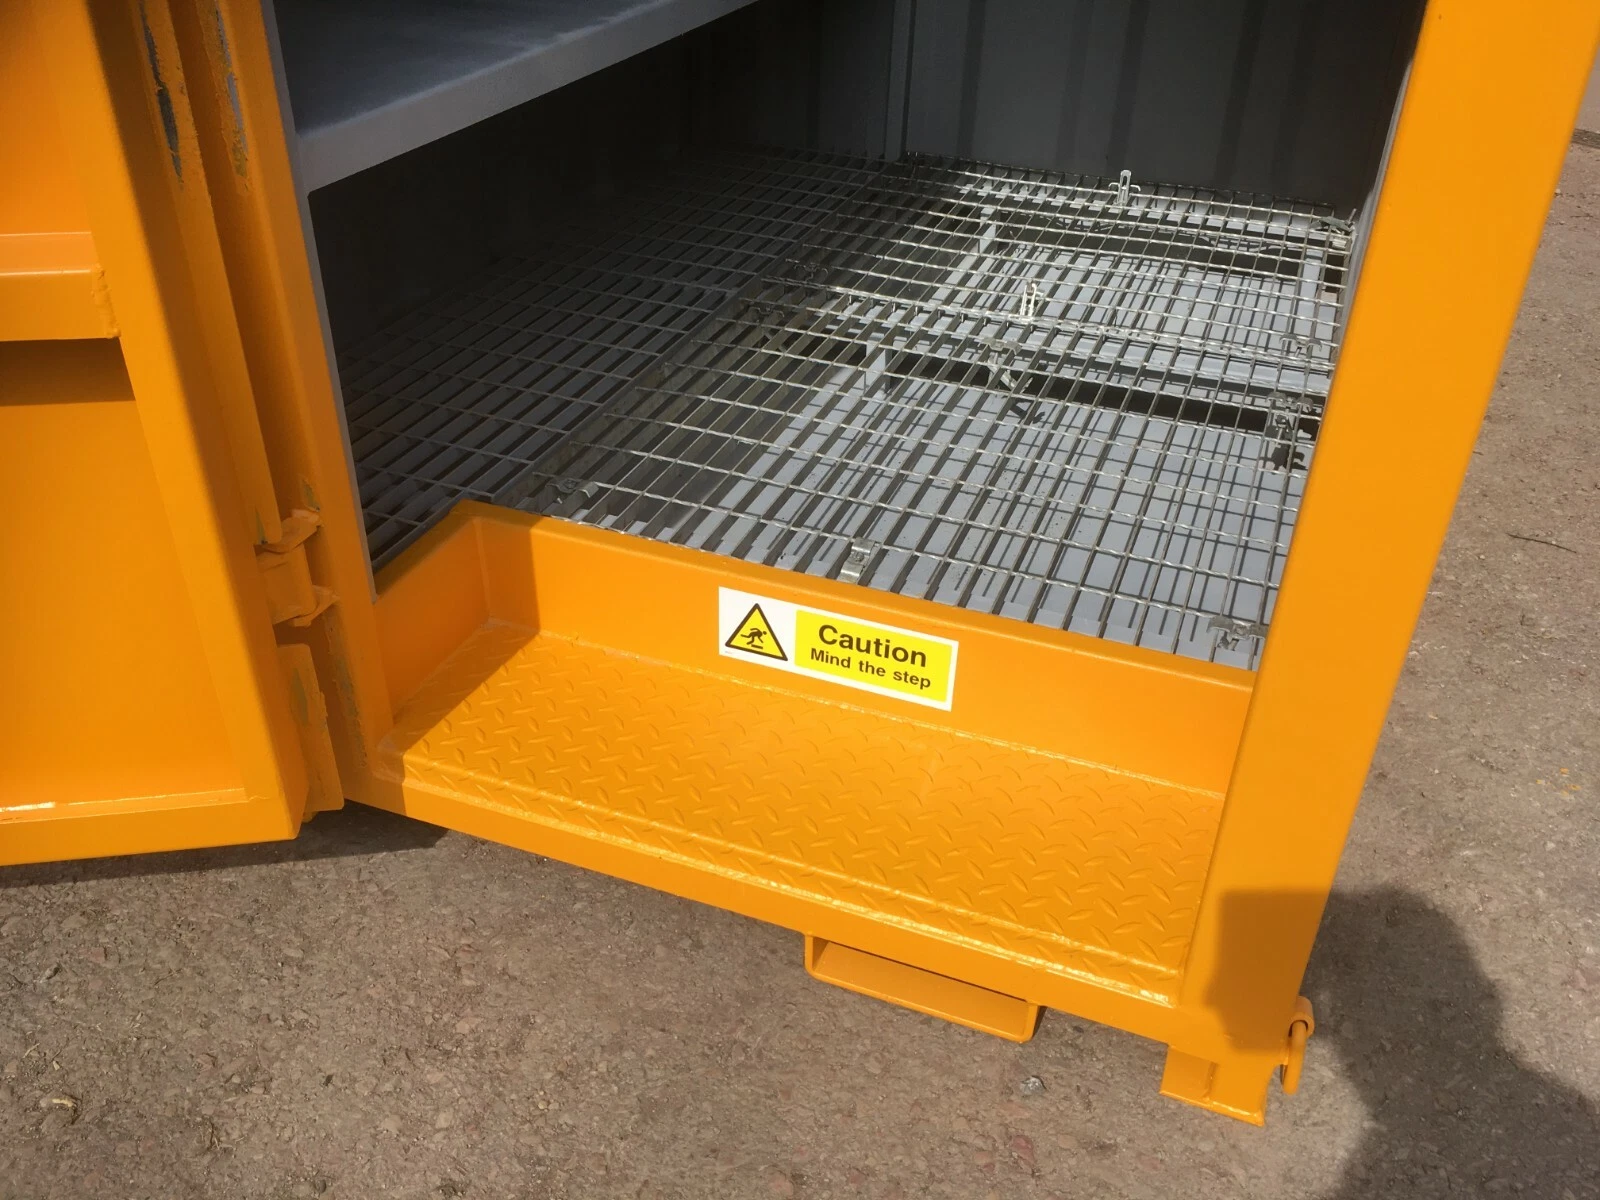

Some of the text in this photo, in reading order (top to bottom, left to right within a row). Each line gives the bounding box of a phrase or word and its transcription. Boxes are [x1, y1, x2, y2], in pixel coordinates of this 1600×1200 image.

[818, 624, 927, 667] Caution
[810, 648, 931, 690] Mind the step
